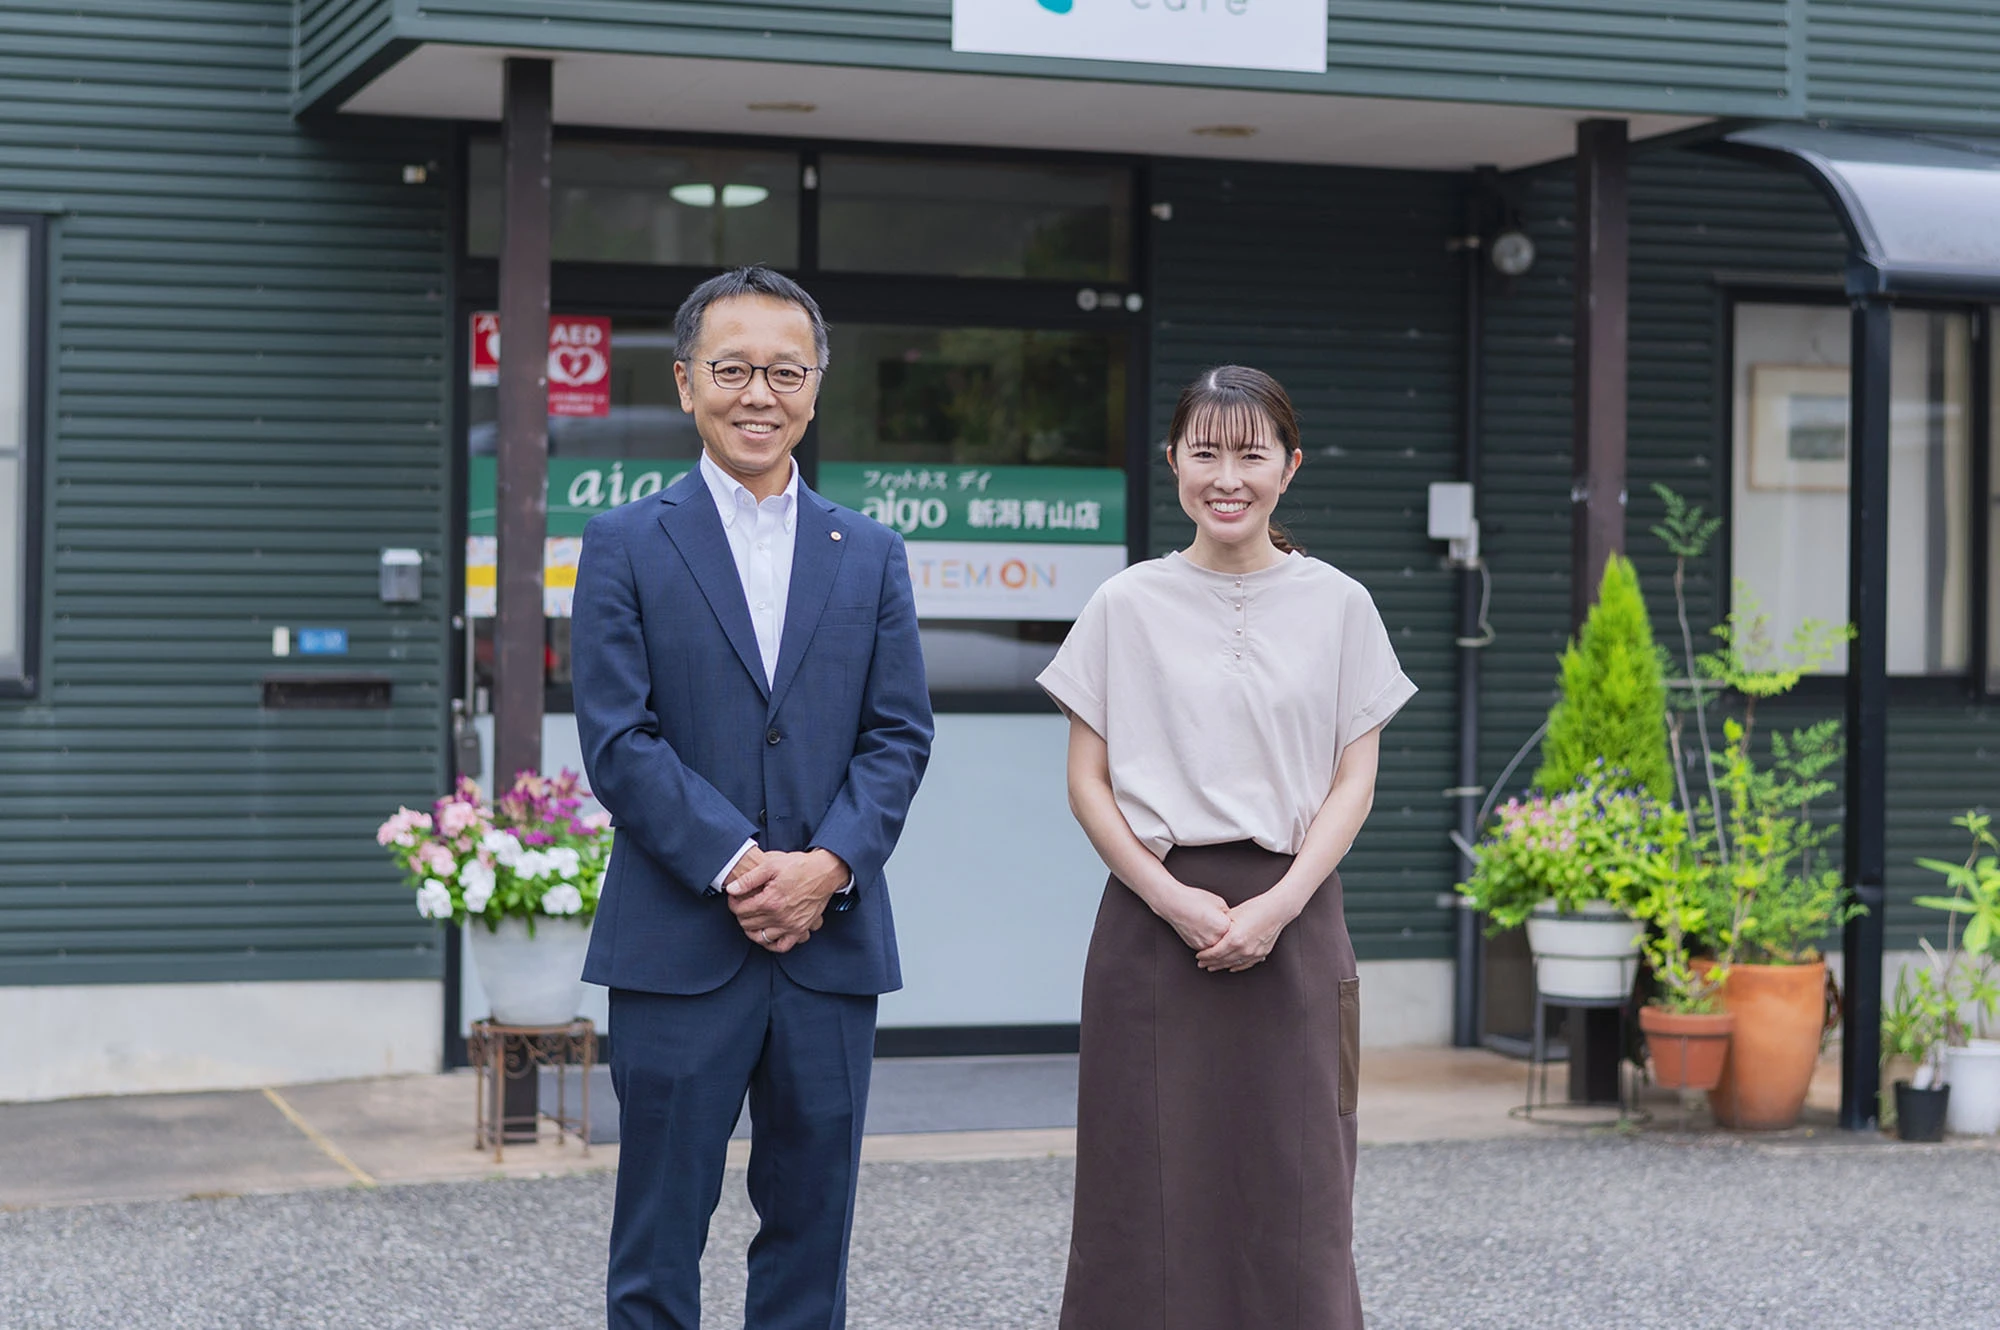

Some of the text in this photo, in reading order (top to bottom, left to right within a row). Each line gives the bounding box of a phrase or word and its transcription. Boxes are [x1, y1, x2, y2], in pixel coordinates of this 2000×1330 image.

[551, 323, 602, 346] AED
[863, 469, 948, 491] フィットネス
[861, 488, 1100, 535] aigo 新潟青山店
[910, 557, 1057, 590] TEMON
